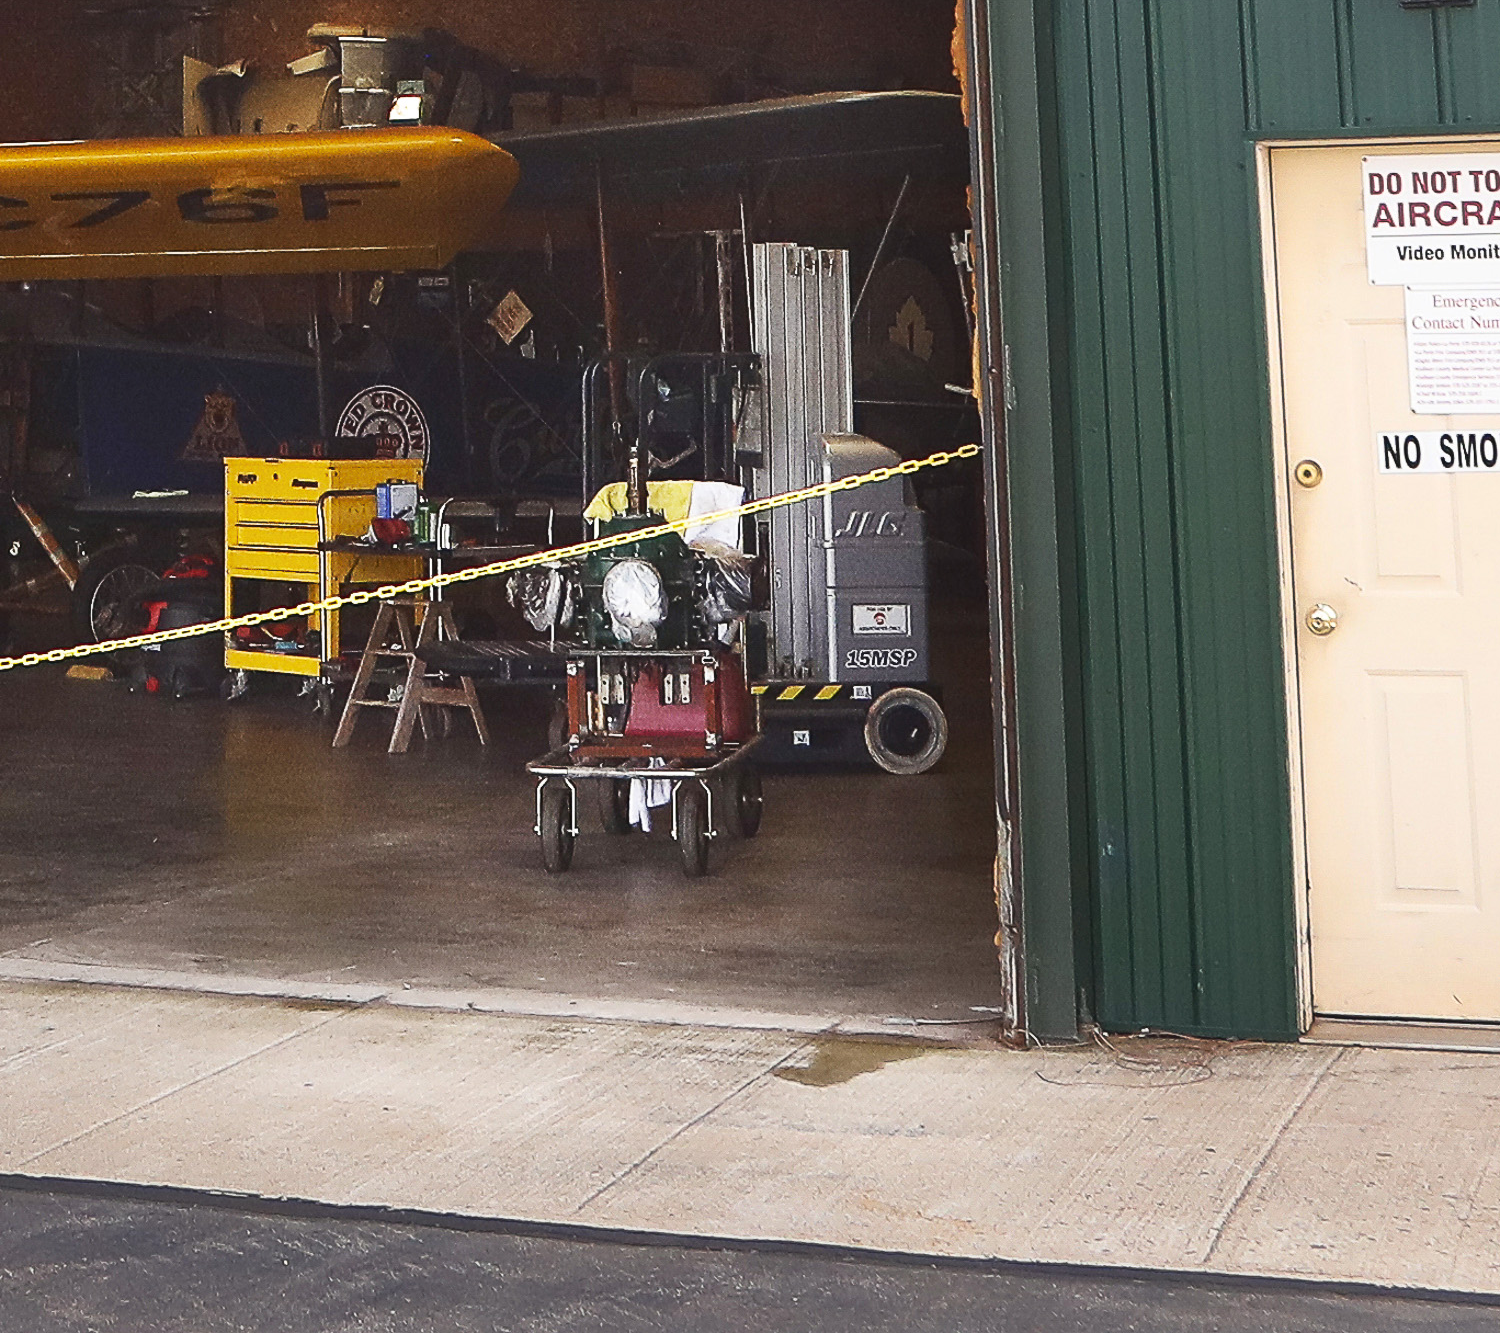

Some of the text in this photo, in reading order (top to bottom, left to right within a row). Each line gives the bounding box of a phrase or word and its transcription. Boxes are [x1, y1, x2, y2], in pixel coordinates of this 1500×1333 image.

[1368, 172, 1402, 195] DO
[1411, 171, 1462, 194] NOT
[1396, 245, 1445, 261] Video
[1411, 316, 1464, 330] Contact
[341, 392, 425, 451] ED CROWN
[1382, 434, 1421, 470] NO
[845, 648, 918, 669] 15MSP
